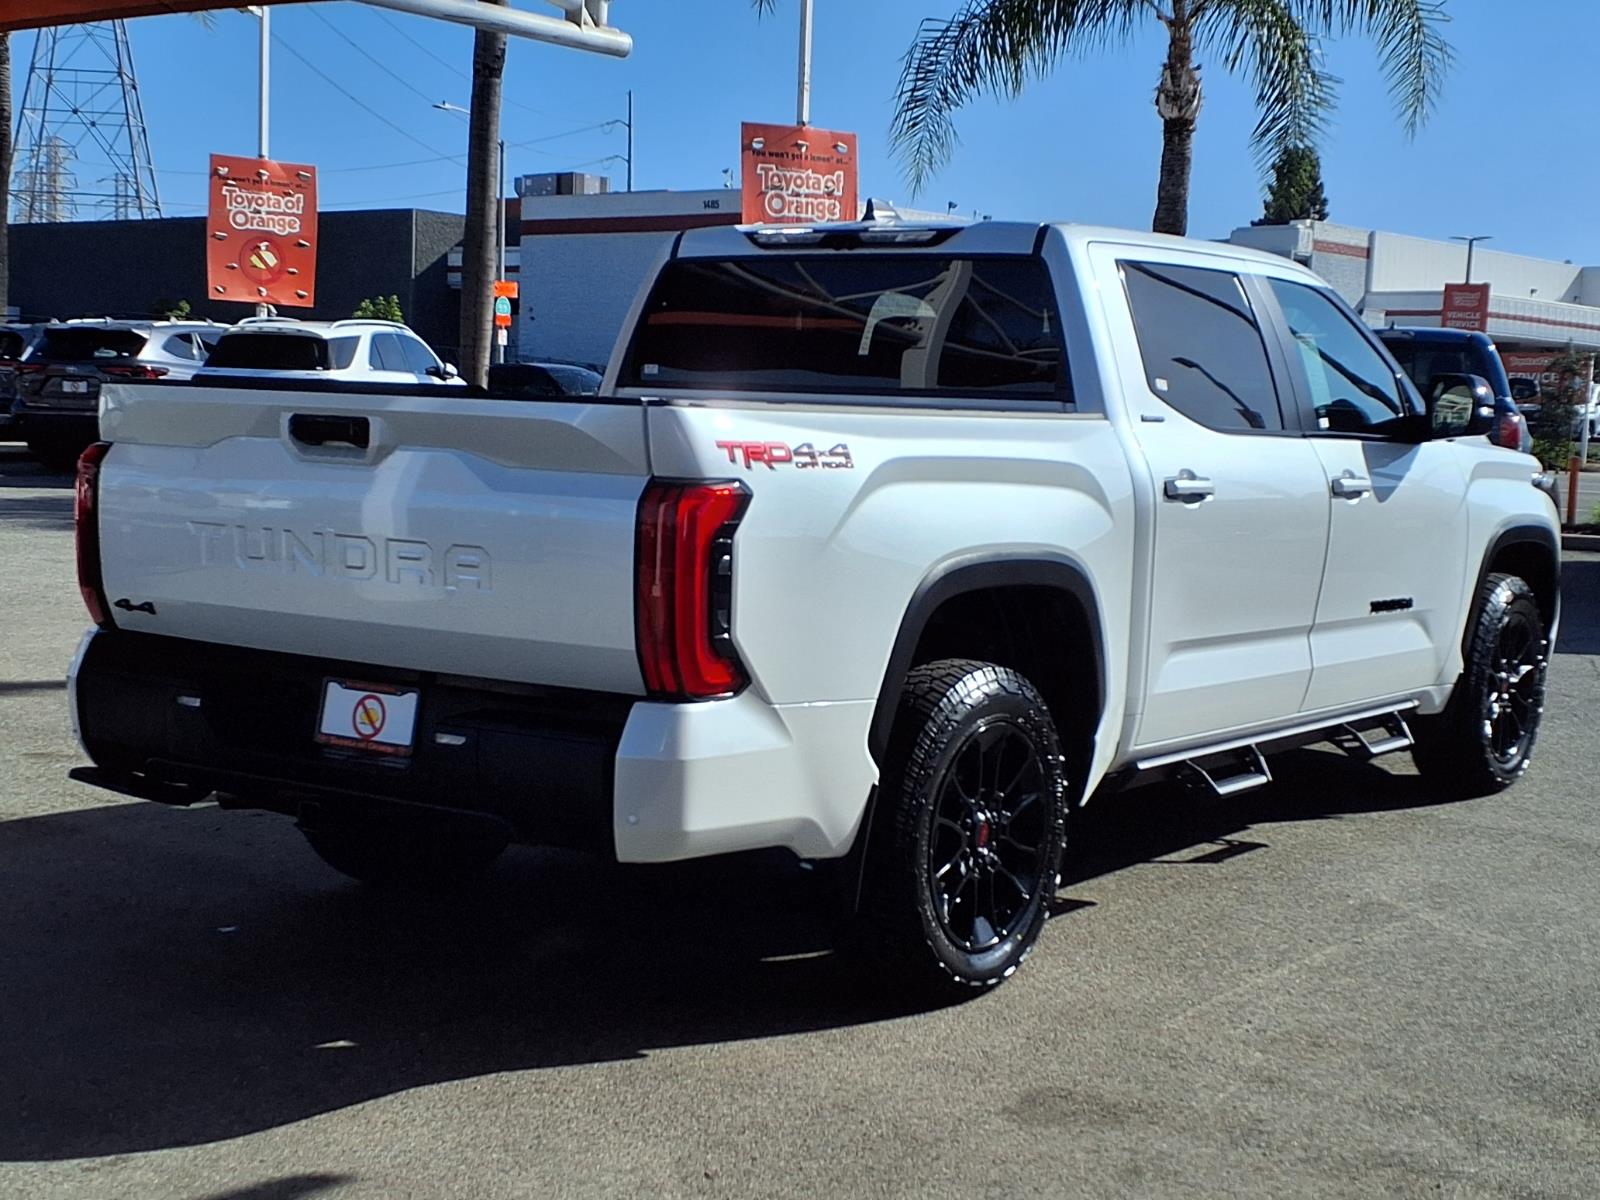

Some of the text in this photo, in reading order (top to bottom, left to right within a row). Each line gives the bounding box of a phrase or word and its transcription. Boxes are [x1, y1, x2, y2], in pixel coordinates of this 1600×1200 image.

[757, 164, 844, 197] Toyota of
[222, 186, 304, 214] Toyota of
[765, 190, 840, 221] Orange
[229, 208, 300, 236] Orange
[1446, 320, 1480, 328] SERVICE
[1447, 311, 1481, 319] VEHICLE
[714, 440, 793, 470] TRD
[795, 460, 854, 469] OFF ROAD
[187, 519, 494, 594] TUNDRA
